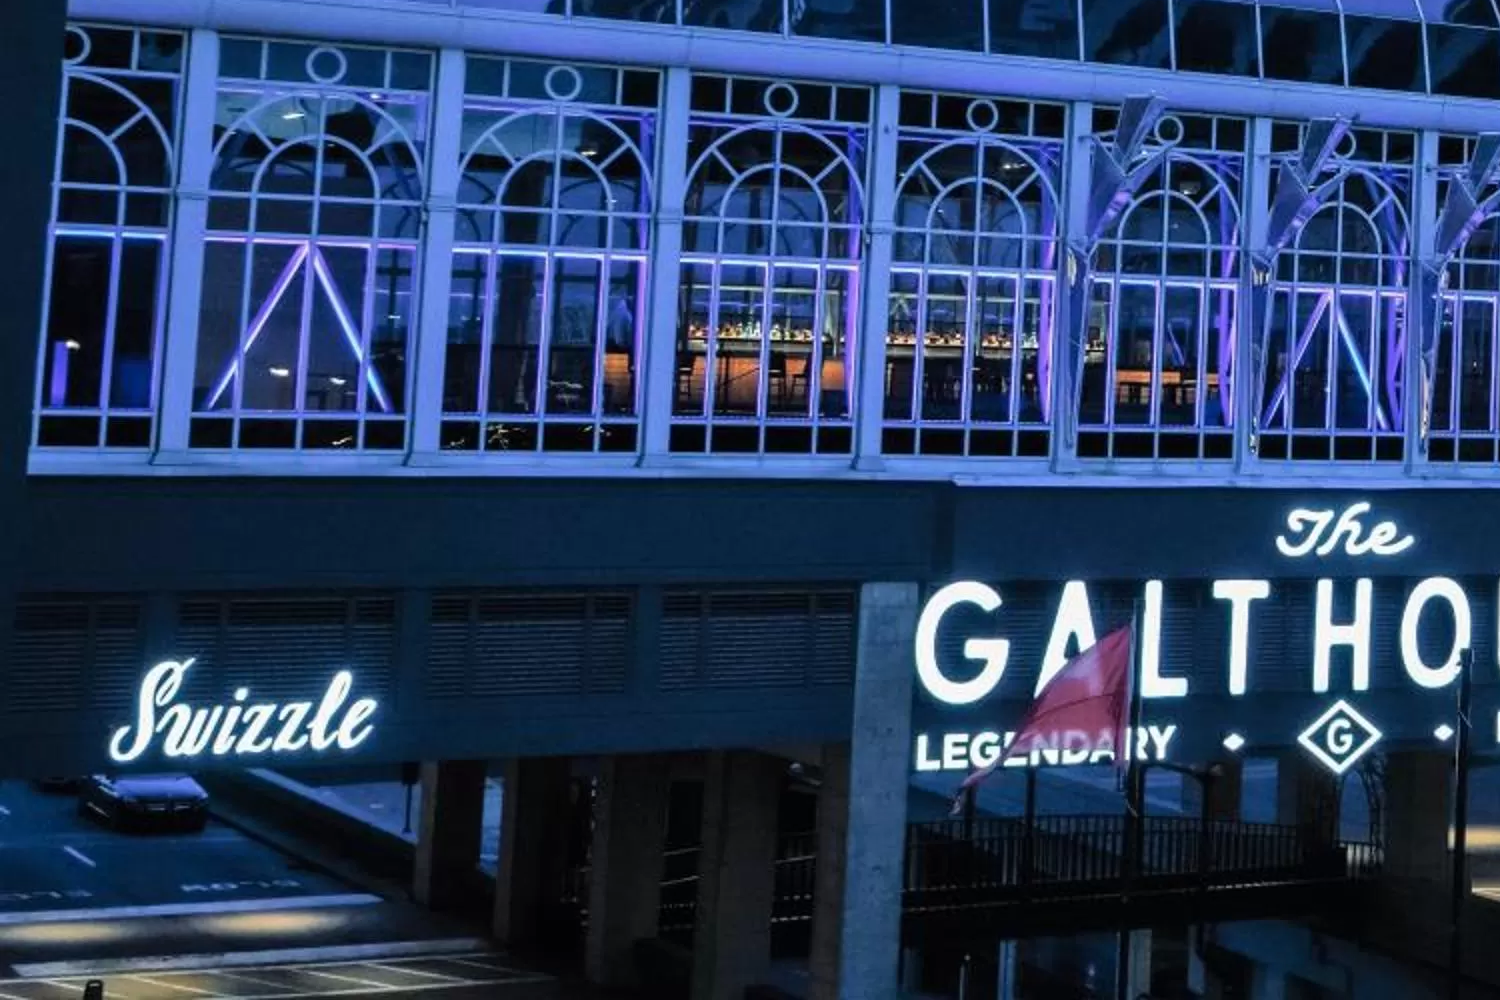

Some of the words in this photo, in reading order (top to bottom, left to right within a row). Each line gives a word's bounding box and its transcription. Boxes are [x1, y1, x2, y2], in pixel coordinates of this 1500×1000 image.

[1276, 502, 1414, 556] The
[915, 579, 1270, 704] GALT
[110, 657, 377, 761] Swizzle
[1327, 717, 1354, 755] G
